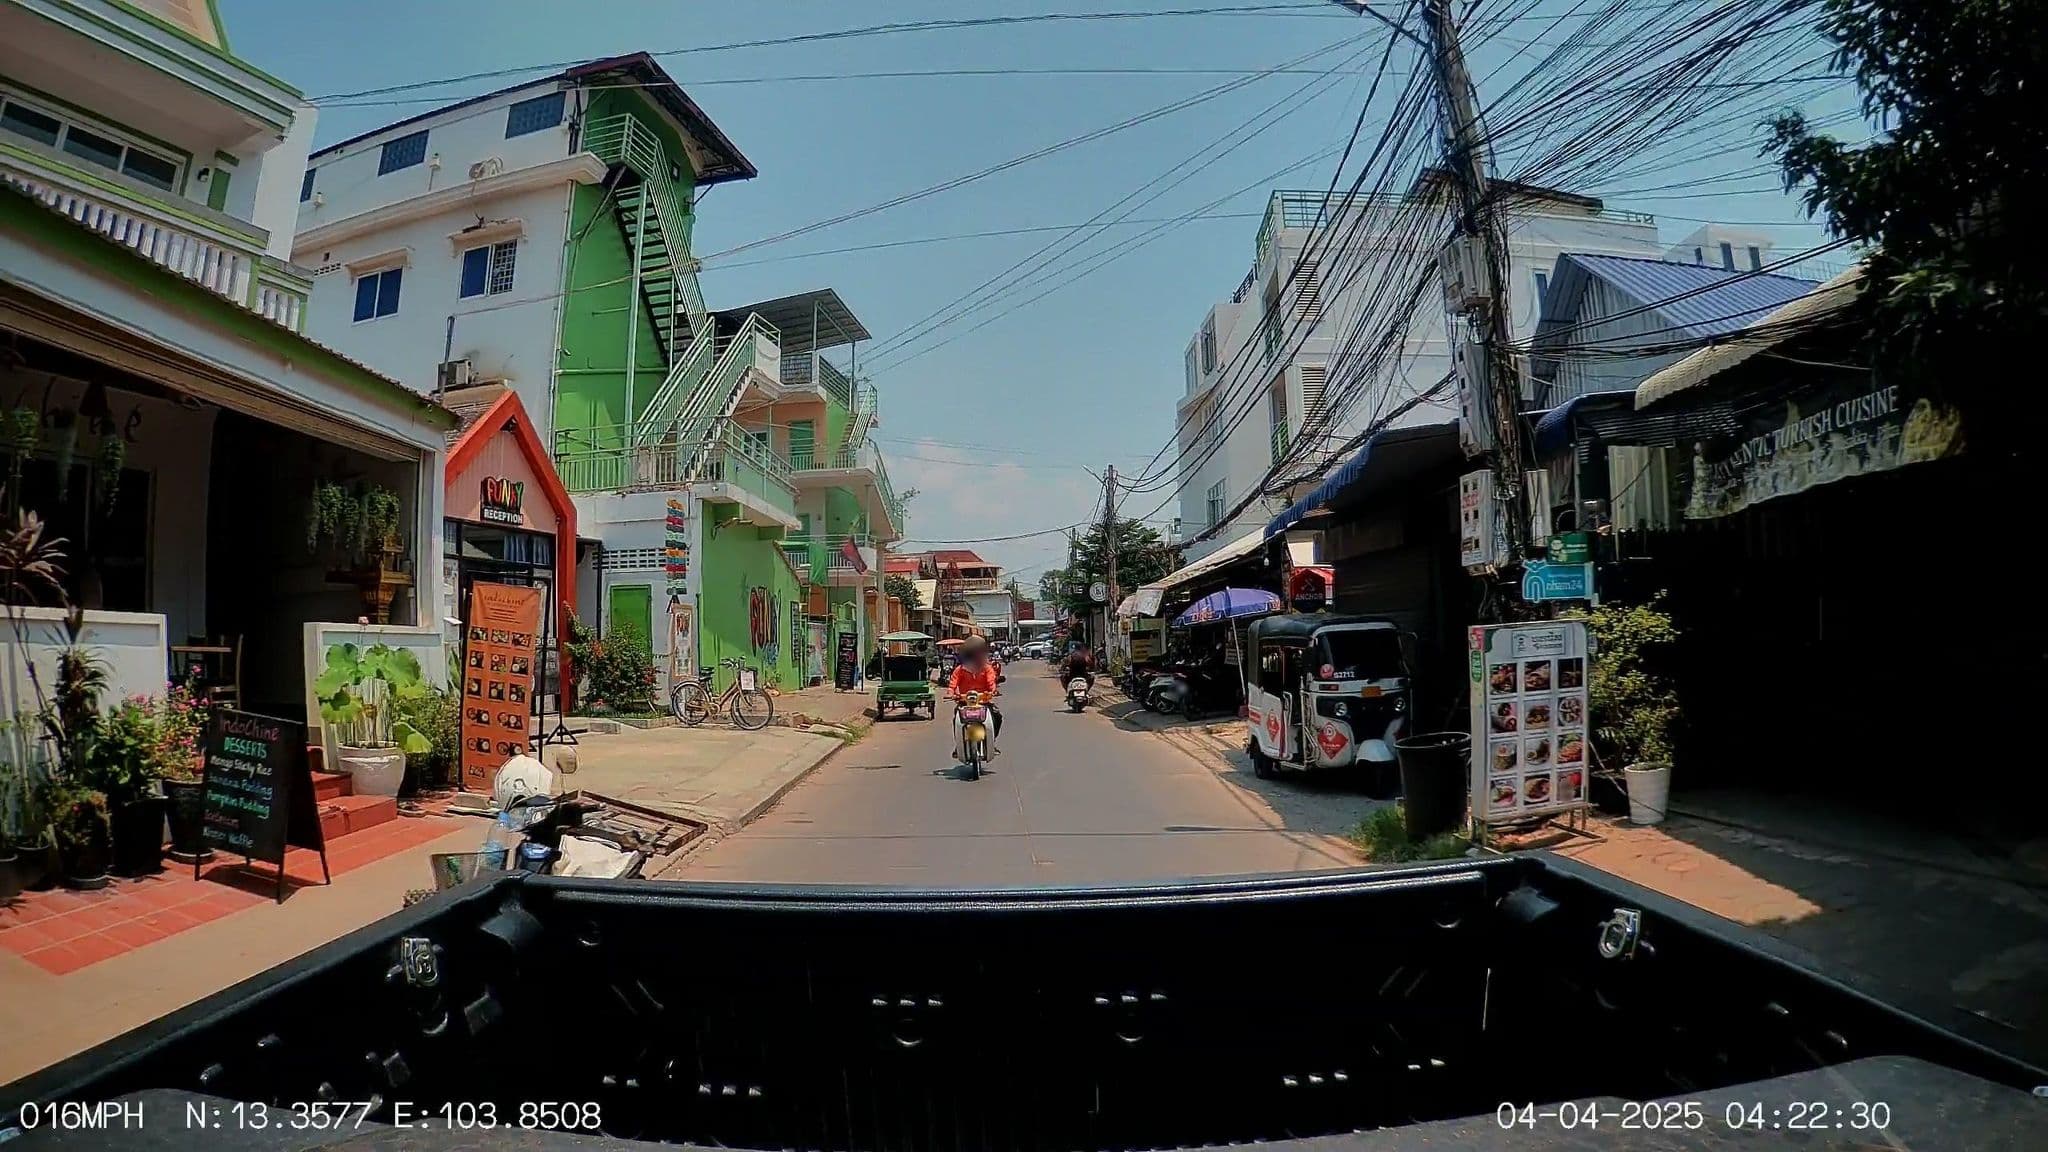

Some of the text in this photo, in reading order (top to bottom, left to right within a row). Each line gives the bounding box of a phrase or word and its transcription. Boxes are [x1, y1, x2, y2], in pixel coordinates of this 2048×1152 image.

[1772, 408, 1832, 454] TURKISH
[1835, 384, 1899, 428] CUISINE
[486, 477, 523, 509] FUNKY
[484, 508, 523, 524] RECEPTION
[1294, 592, 1323, 601] ANCHOR
[223, 736, 268, 759] DESSERTS
[234, 759, 256, 778] Sticky
[256, 763, 273, 776] Rice
[239, 797, 271, 820] Pudding
